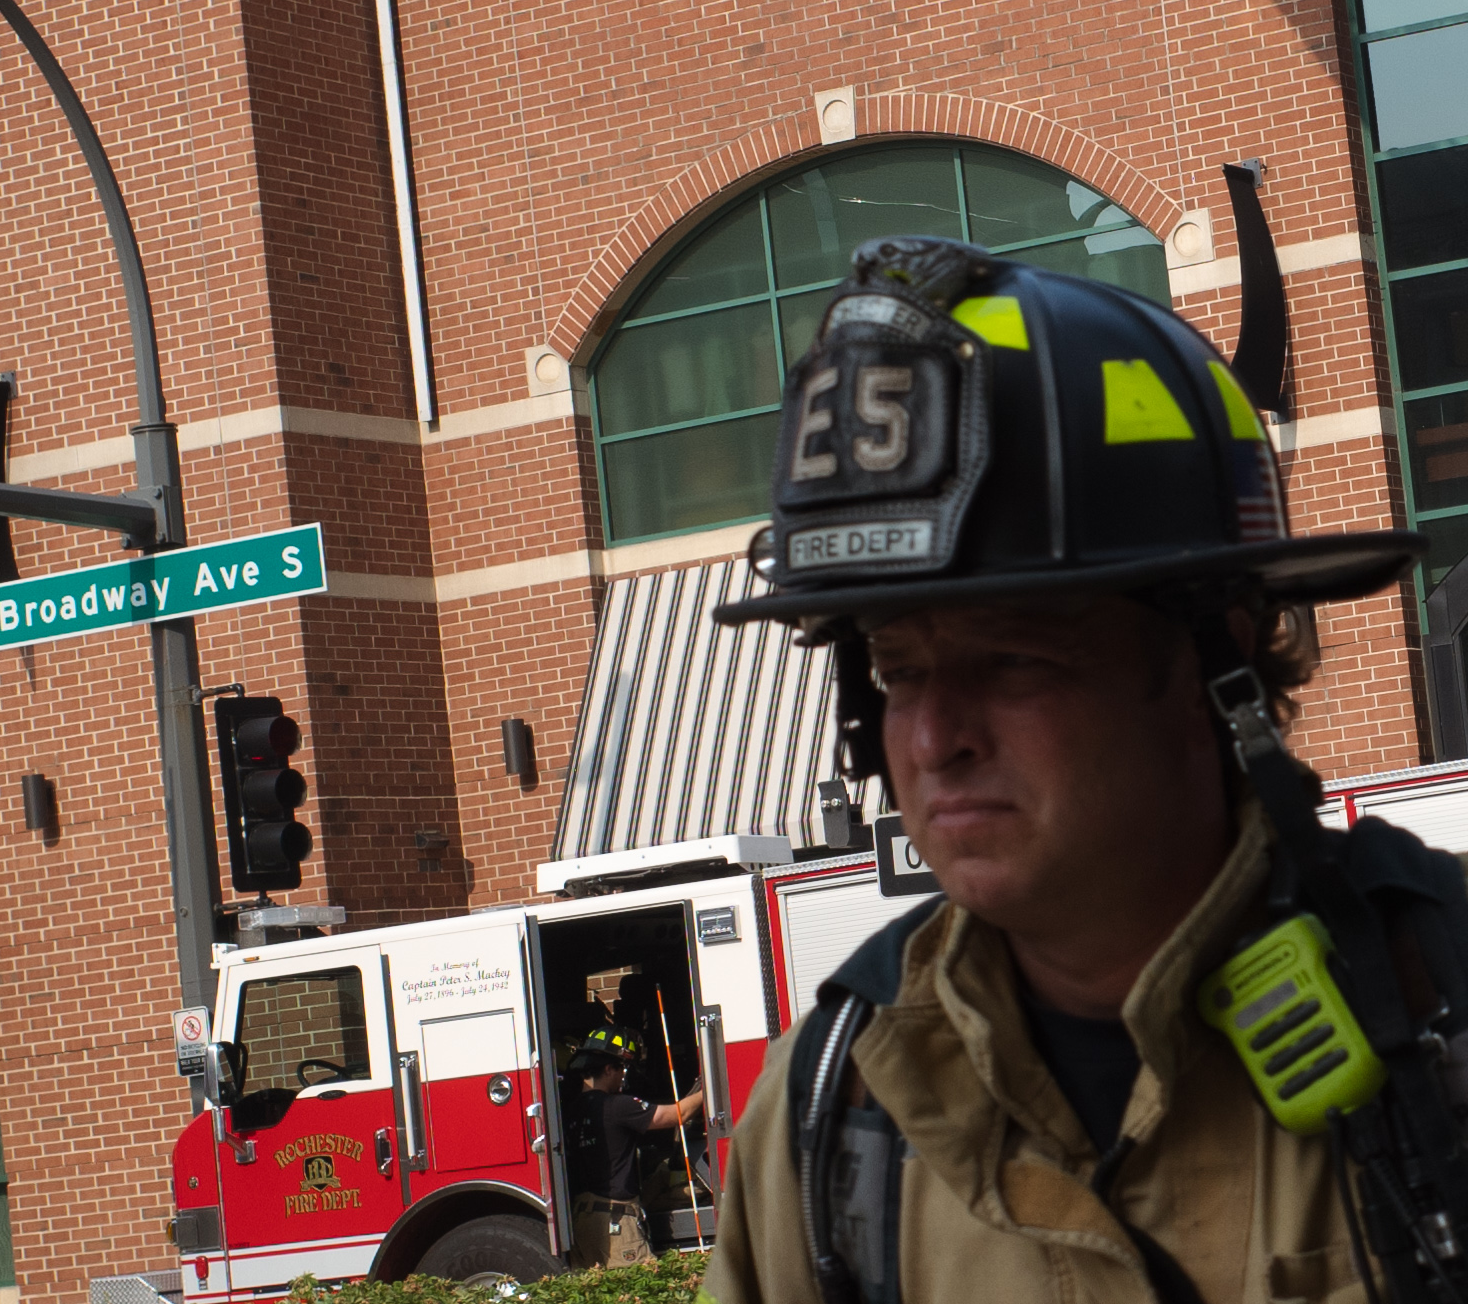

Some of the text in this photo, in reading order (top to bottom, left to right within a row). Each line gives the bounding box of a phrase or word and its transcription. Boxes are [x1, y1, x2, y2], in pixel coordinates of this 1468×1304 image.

[790, 365, 913, 482] E5
[847, 528, 920, 556] DEPT
[192, 556, 262, 595] Ave
[282, 546, 305, 579] S
[402, 980, 437, 992] Captain
[439, 974, 462, 986] Peter
[474, 967, 511, 981] Mackey
[407, 993, 422, 1005] July
[461, 985, 477, 997] July
[273, 1133, 364, 1169] ROCHESTER
[284, 1188, 363, 1219] FIRE DEPT.
